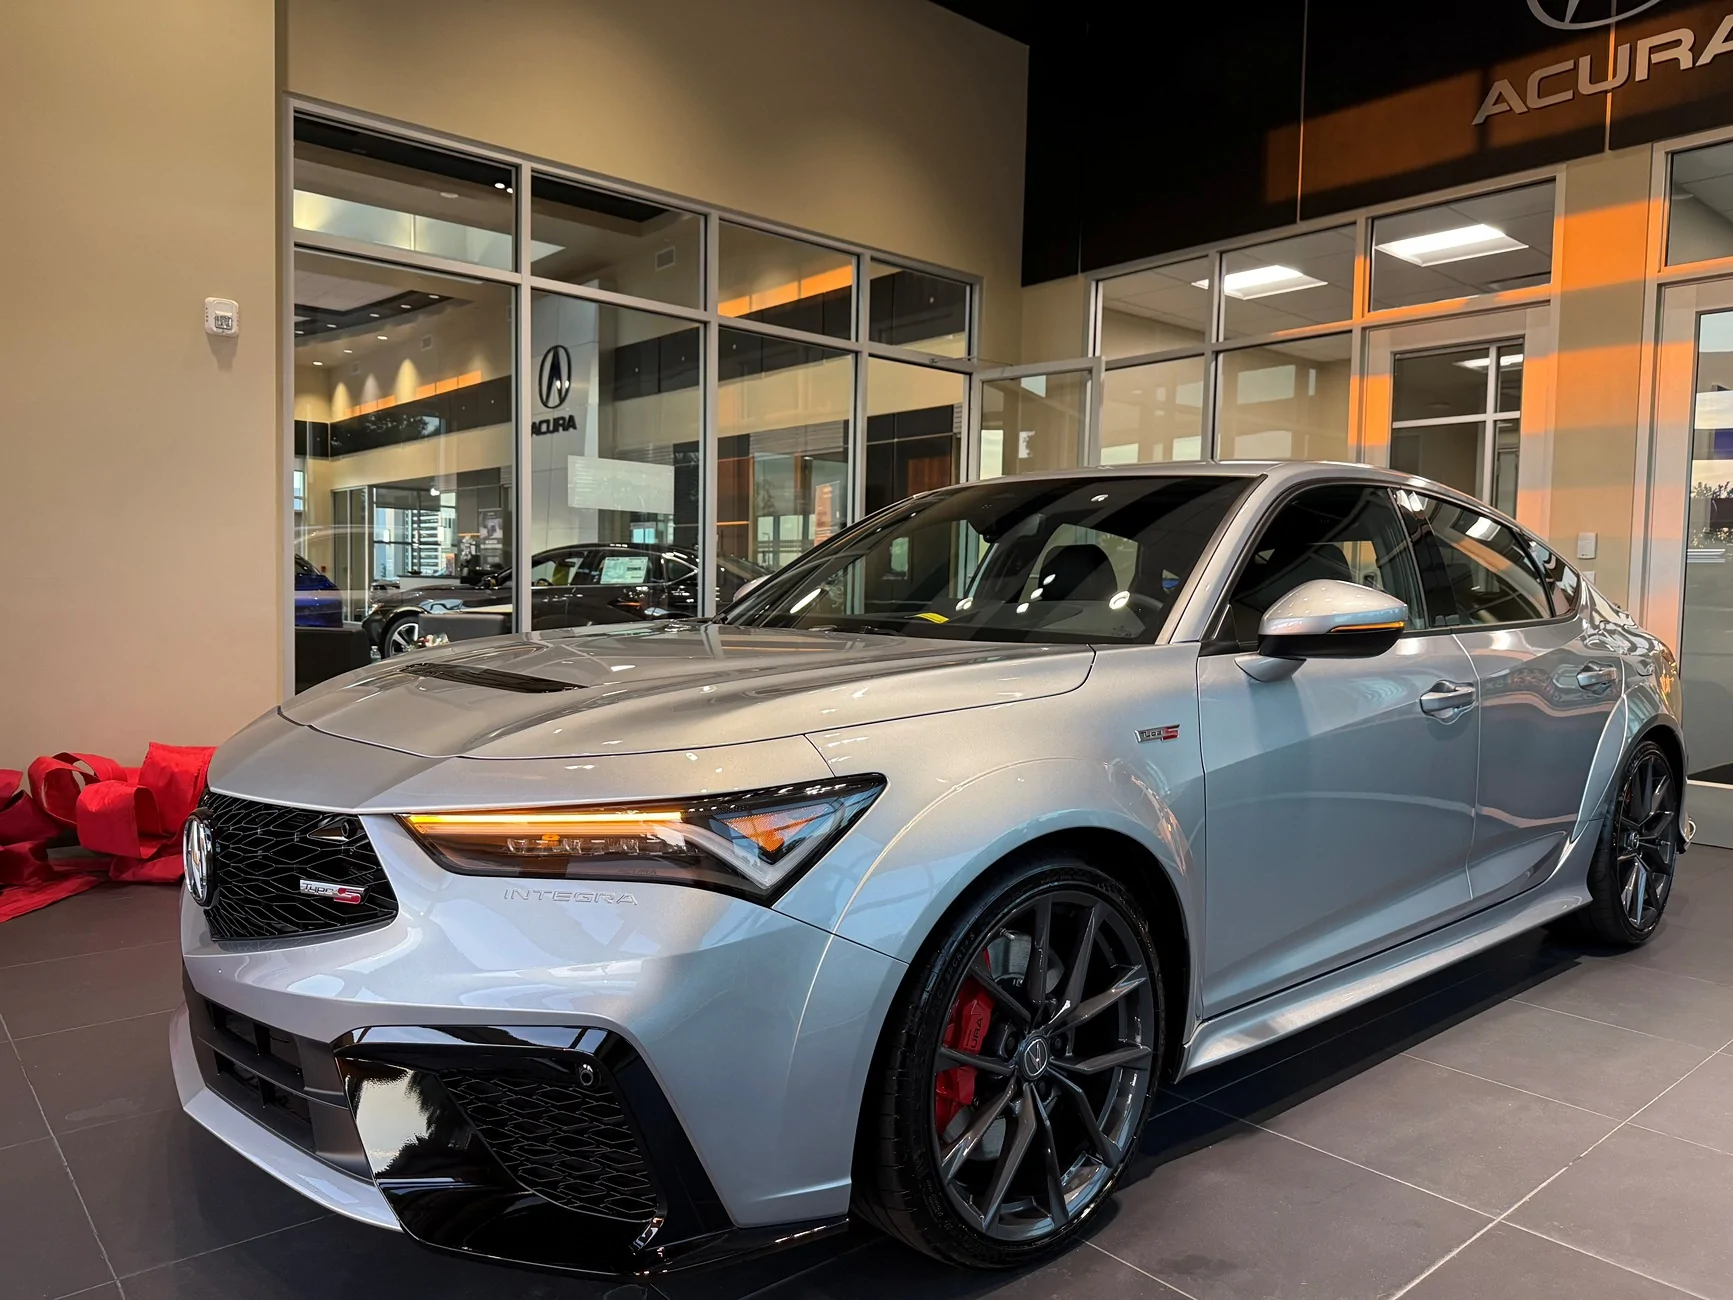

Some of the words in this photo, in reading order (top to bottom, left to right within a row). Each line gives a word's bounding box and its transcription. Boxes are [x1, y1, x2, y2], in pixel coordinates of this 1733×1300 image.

[531, 415, 577, 436] ACURA
[334, 887, 363, 905] S
[503, 888, 639, 906] INTEGRA
